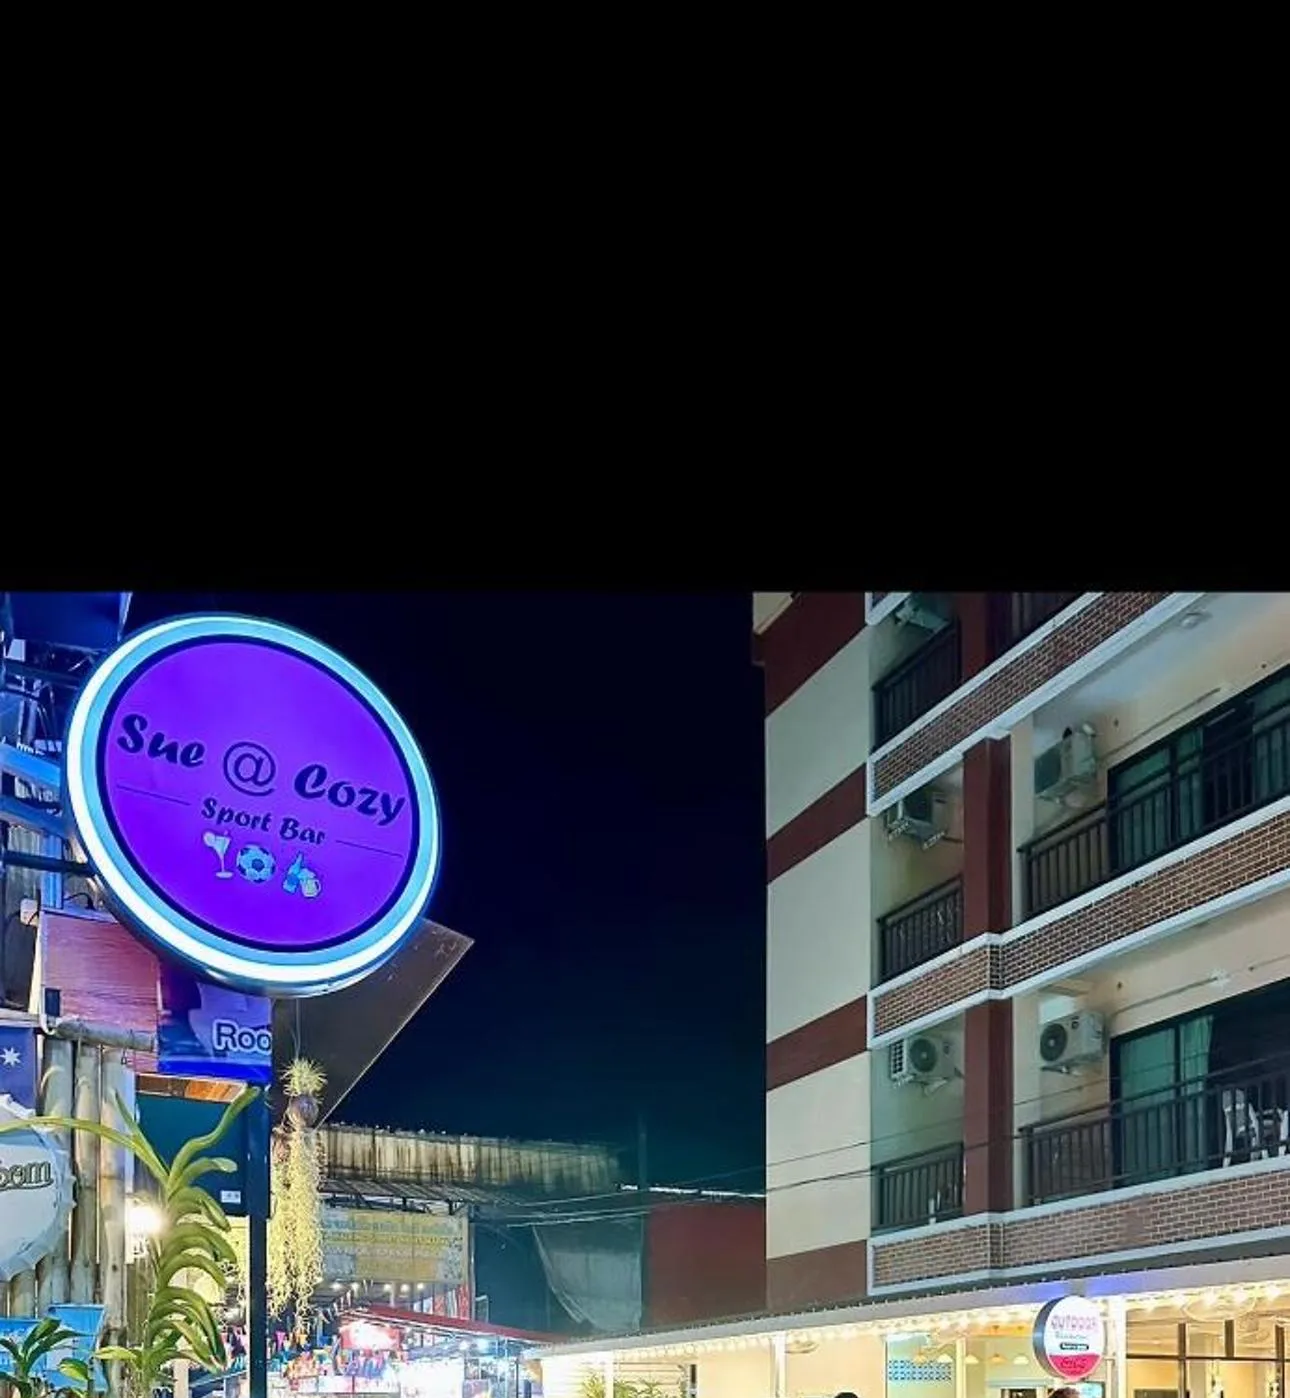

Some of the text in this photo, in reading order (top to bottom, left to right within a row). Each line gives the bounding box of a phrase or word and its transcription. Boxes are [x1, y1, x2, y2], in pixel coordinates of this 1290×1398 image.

[117, 713, 406, 826] Sue @ Cozy
[201, 797, 326, 845] Sport Bar
